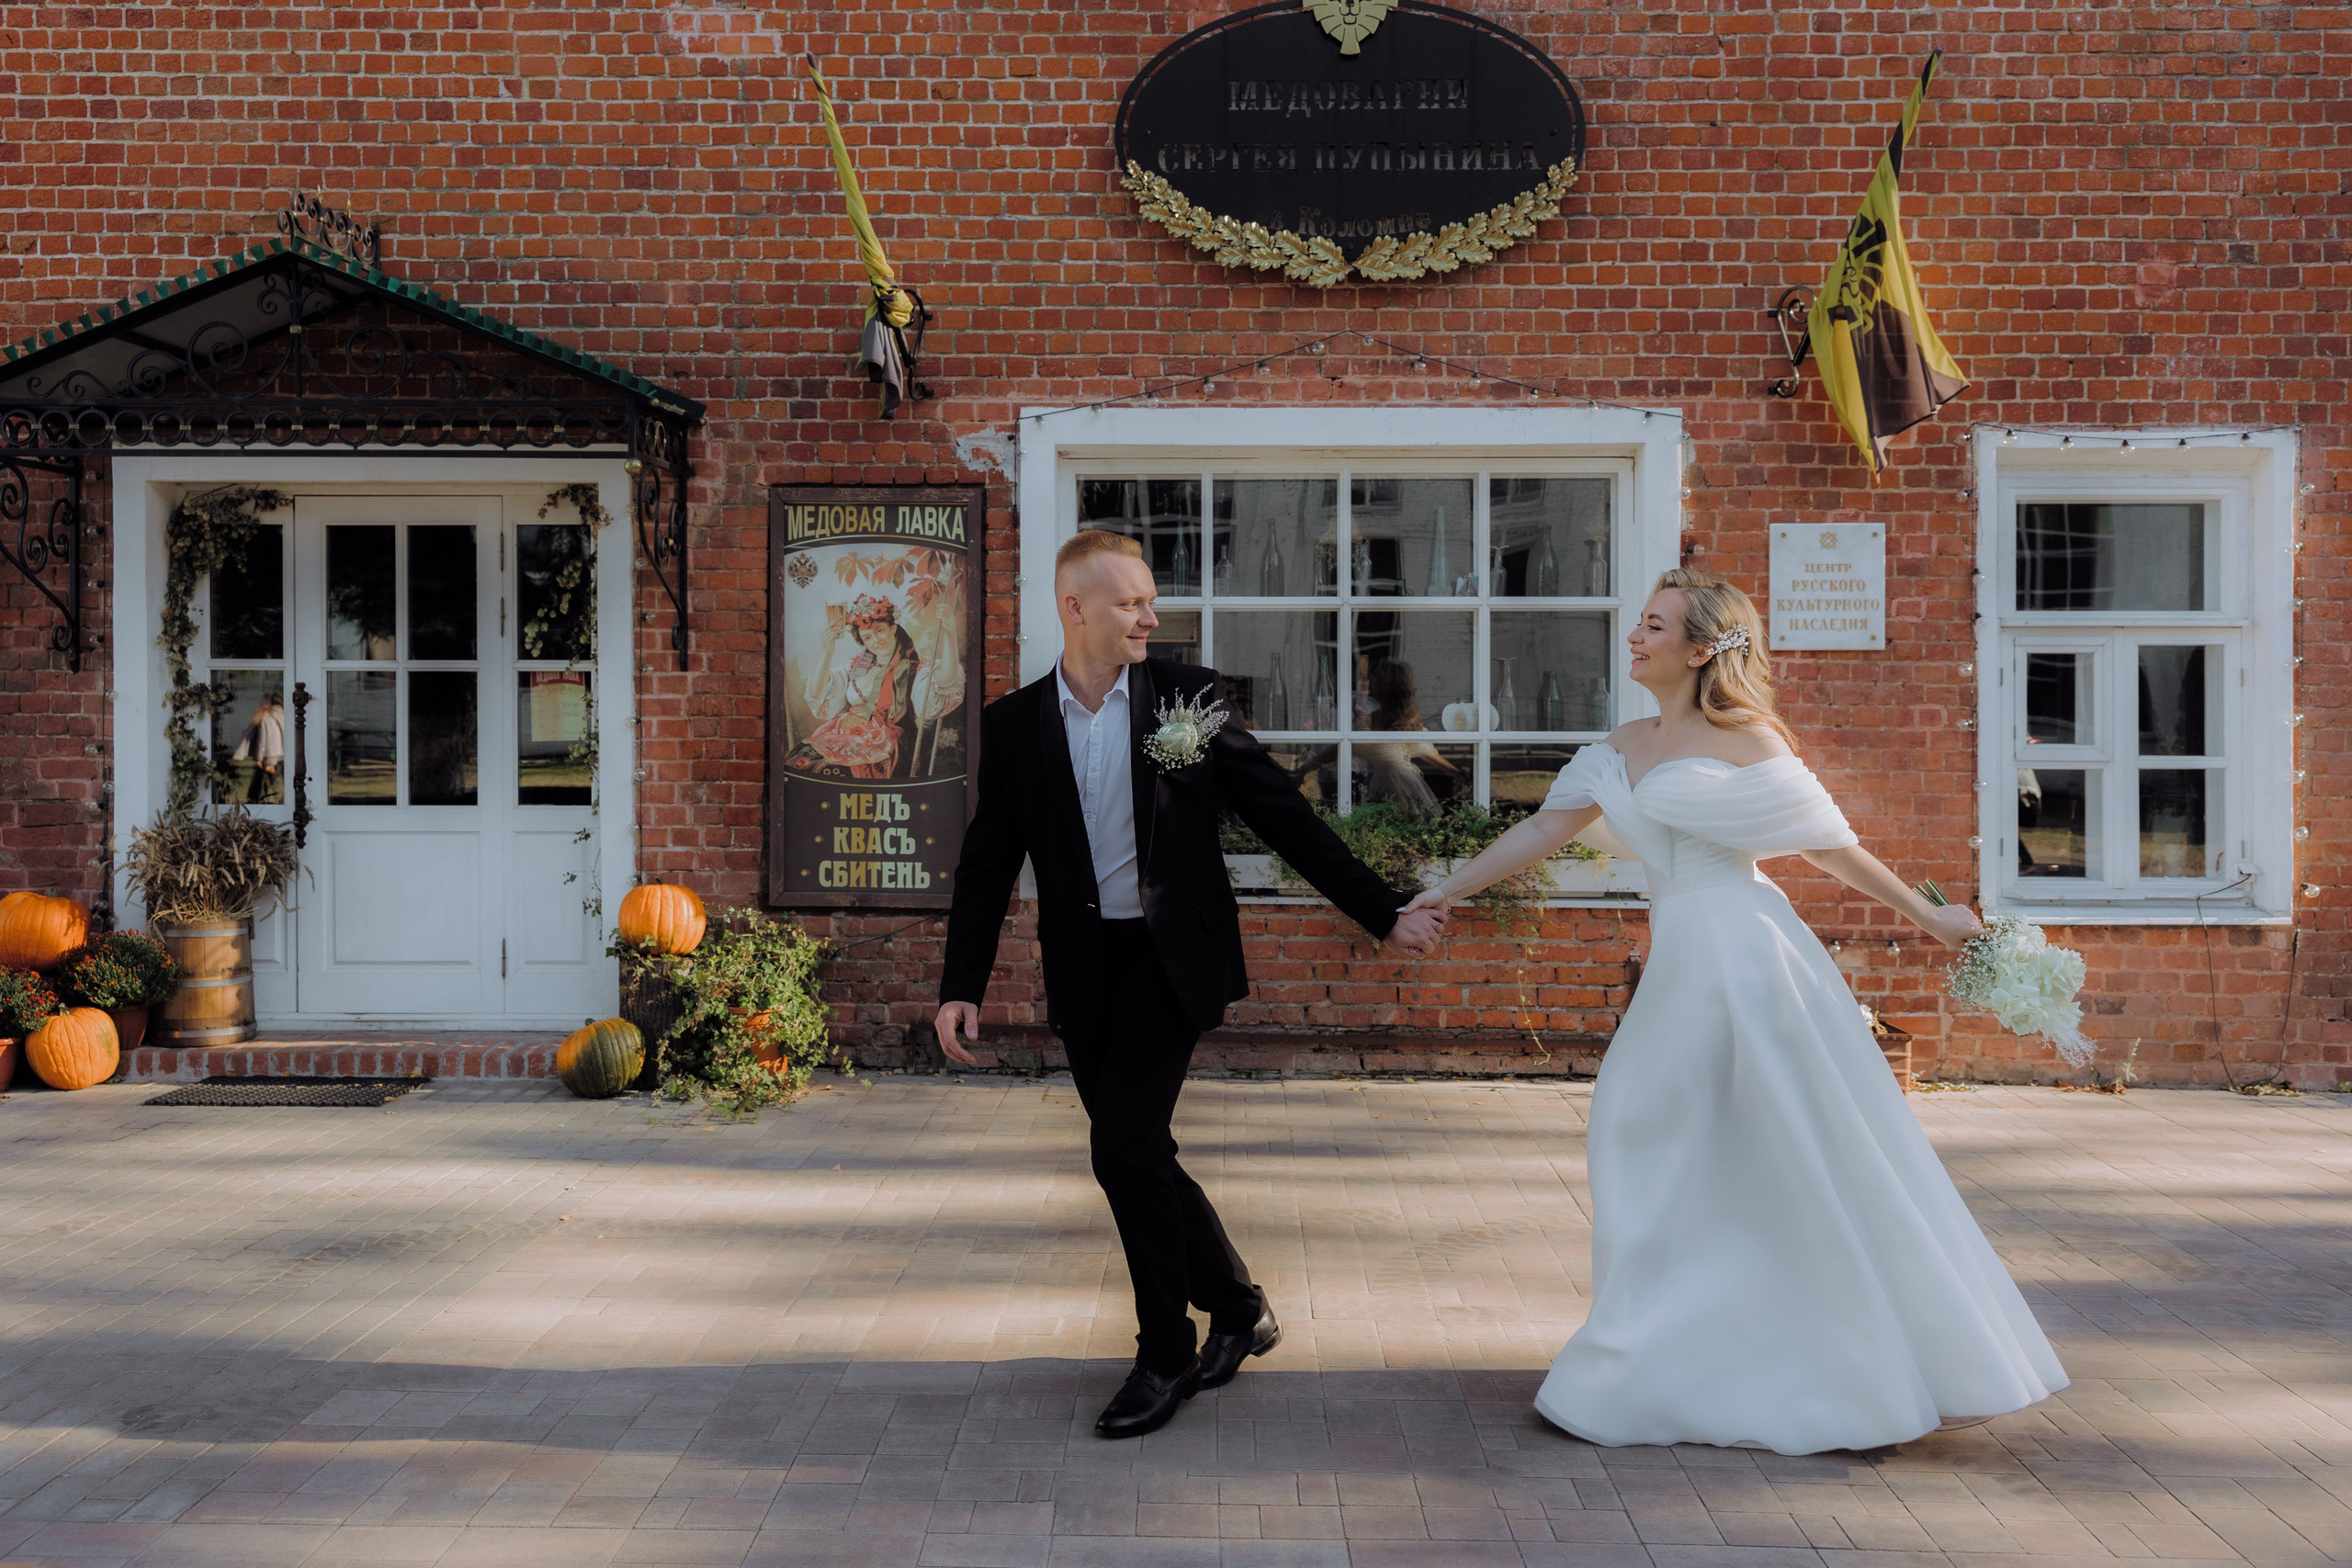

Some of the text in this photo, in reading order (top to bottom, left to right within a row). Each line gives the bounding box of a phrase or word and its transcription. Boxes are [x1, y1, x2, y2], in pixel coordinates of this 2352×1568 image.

[1227, 78, 1469, 118] МЕДОВАРНИ
[1157, 139, 1544, 174] СЕРГЕЯ ПУПЫНИНА
[787, 505, 966, 543] МЕДОВАЯ ЛАВКА
[1804, 563, 1852, 574] ЦЕНТР
[1792, 580, 1866, 592] РУССКОГО
[1776, 599, 1880, 612] КУЛЬТУРНОГО
[1789, 618, 1869, 632] НАСЛЕДИЯ
[839, 793, 910, 823] МЕДЪ
[833, 827, 916, 856] КВАСЪ
[819, 861, 931, 889] СБИТЕНЬ
